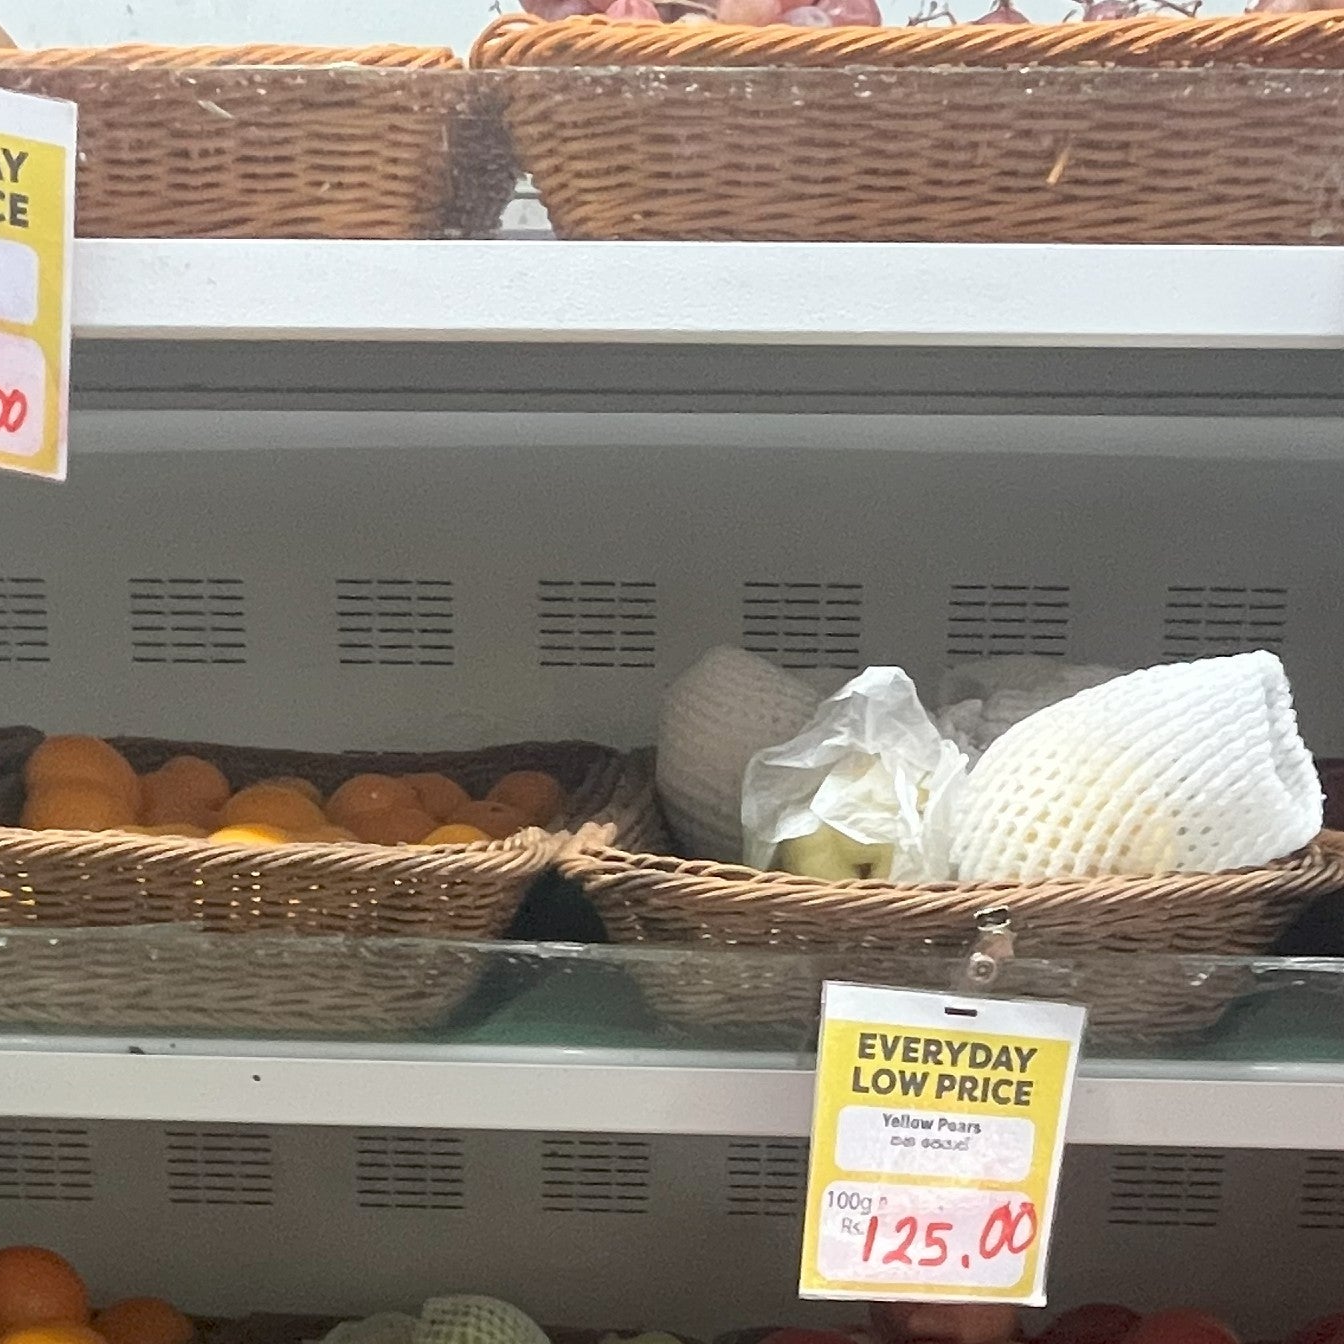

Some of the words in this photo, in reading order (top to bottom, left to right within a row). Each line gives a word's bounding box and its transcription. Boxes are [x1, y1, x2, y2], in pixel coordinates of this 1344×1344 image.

[858, 1032, 1038, 1074] EVERYDAY
[852, 1066, 930, 1098] LOW
[935, 1073, 1034, 1107] PRICE
[882, 1112, 933, 1132] Yellow
[938, 1116, 982, 1135] Pears
[827, 1190, 873, 1214] 100g
[862, 1200, 1038, 1269] 125.00
